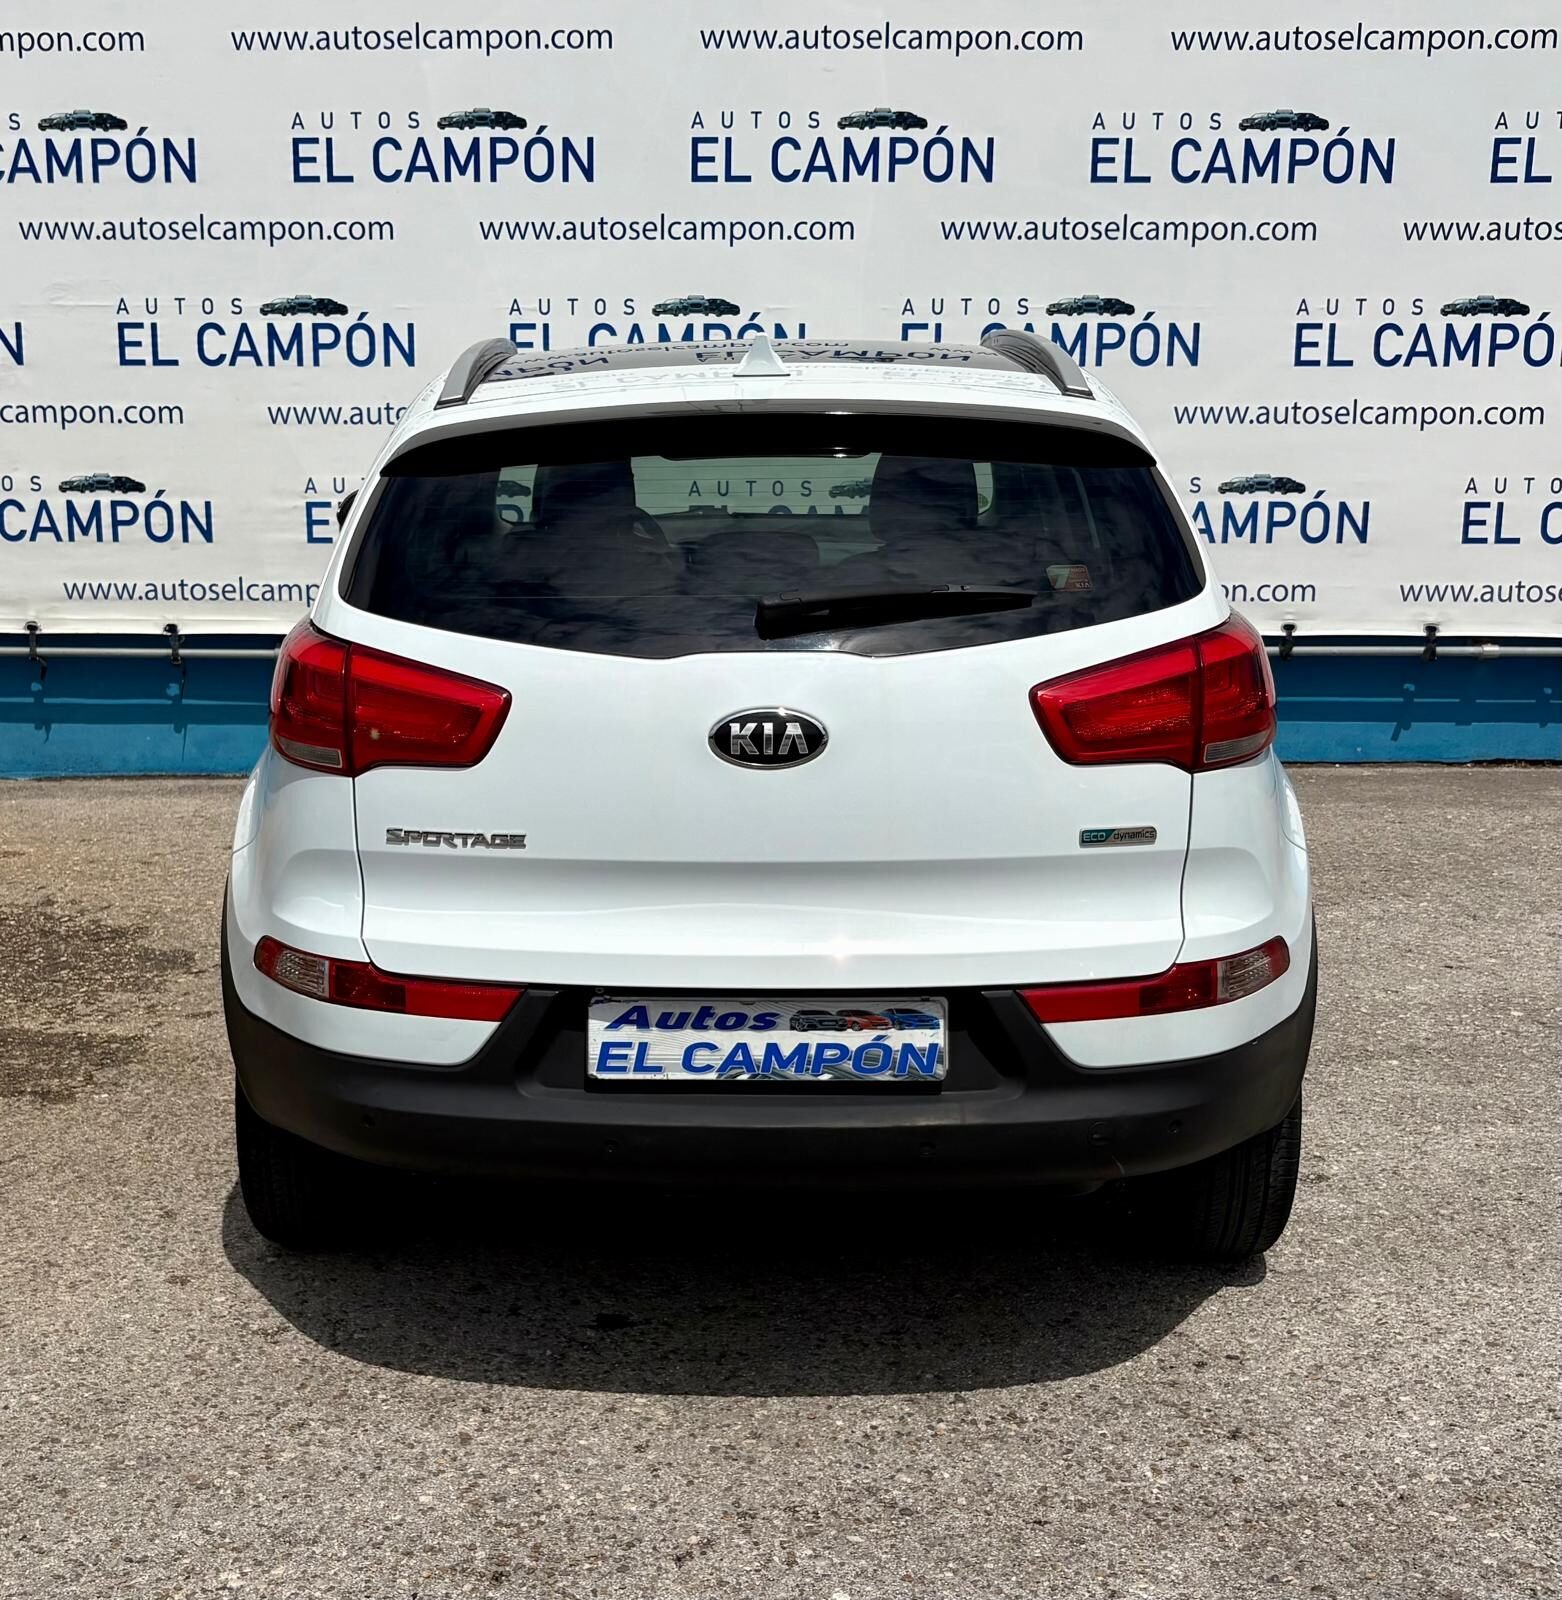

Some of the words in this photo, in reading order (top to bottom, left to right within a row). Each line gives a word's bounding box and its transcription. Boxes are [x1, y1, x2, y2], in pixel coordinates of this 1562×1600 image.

[230, 21, 613, 57] www.autoselcampon.com
[699, 21, 1083, 57] www.autoselcampon.com
[1170, 22, 1558, 58] www.autoselcampon.com
[291, 111, 420, 130] AUTOS
[690, 110, 820, 129] AUTOS
[1091, 111, 1222, 131] AUTOS
[0, 126, 197, 184] AMPÓN
[292, 136, 355, 183] EL
[372, 126, 595, 183] CAMPÓN
[690, 136, 752, 183] EL
[771, 126, 994, 183] CAMPÓN
[1090, 137, 1152, 184] EL
[1171, 126, 1396, 185] CAMPÓN
[1489, 136, 1553, 184] EL
[18, 213, 394, 248] www.autoselcampon.com
[479, 213, 855, 248] www.autoselcampon.com
[940, 213, 1317, 248] www.autoselcampon.com
[116, 297, 243, 315] AUTOS
[509, 298, 635, 316] AUTOS
[901, 297, 1029, 316] AUTOS
[1296, 298, 1424, 316] AUTOS
[117, 321, 180, 367] EL
[196, 311, 416, 368] CAMPÓN
[981, 312, 1201, 368] MPÓN
[1293, 322, 1354, 367] EL
[1373, 311, 1562, 368] CAMPÓ
[1173, 398, 1545, 432] www.autoselcampon.com
[687, 478, 814, 498] AUTOS
[0, 489, 214, 544] CAMPÓN
[1191, 489, 1370, 545] AMPÓN
[1461, 501, 1521, 545] EL
[1399, 580, 1562, 603] www.autos
[729, 722, 808, 756] KIA
[385, 827, 527, 850] SPORTAGE
[1083, 832, 1106, 841] ECO
[1113, 830, 1155, 841] dynamics
[603, 1004, 781, 1032] Autos
[594, 1040, 666, 1075] EL
[680, 1034, 943, 1077] CAMPÓN
